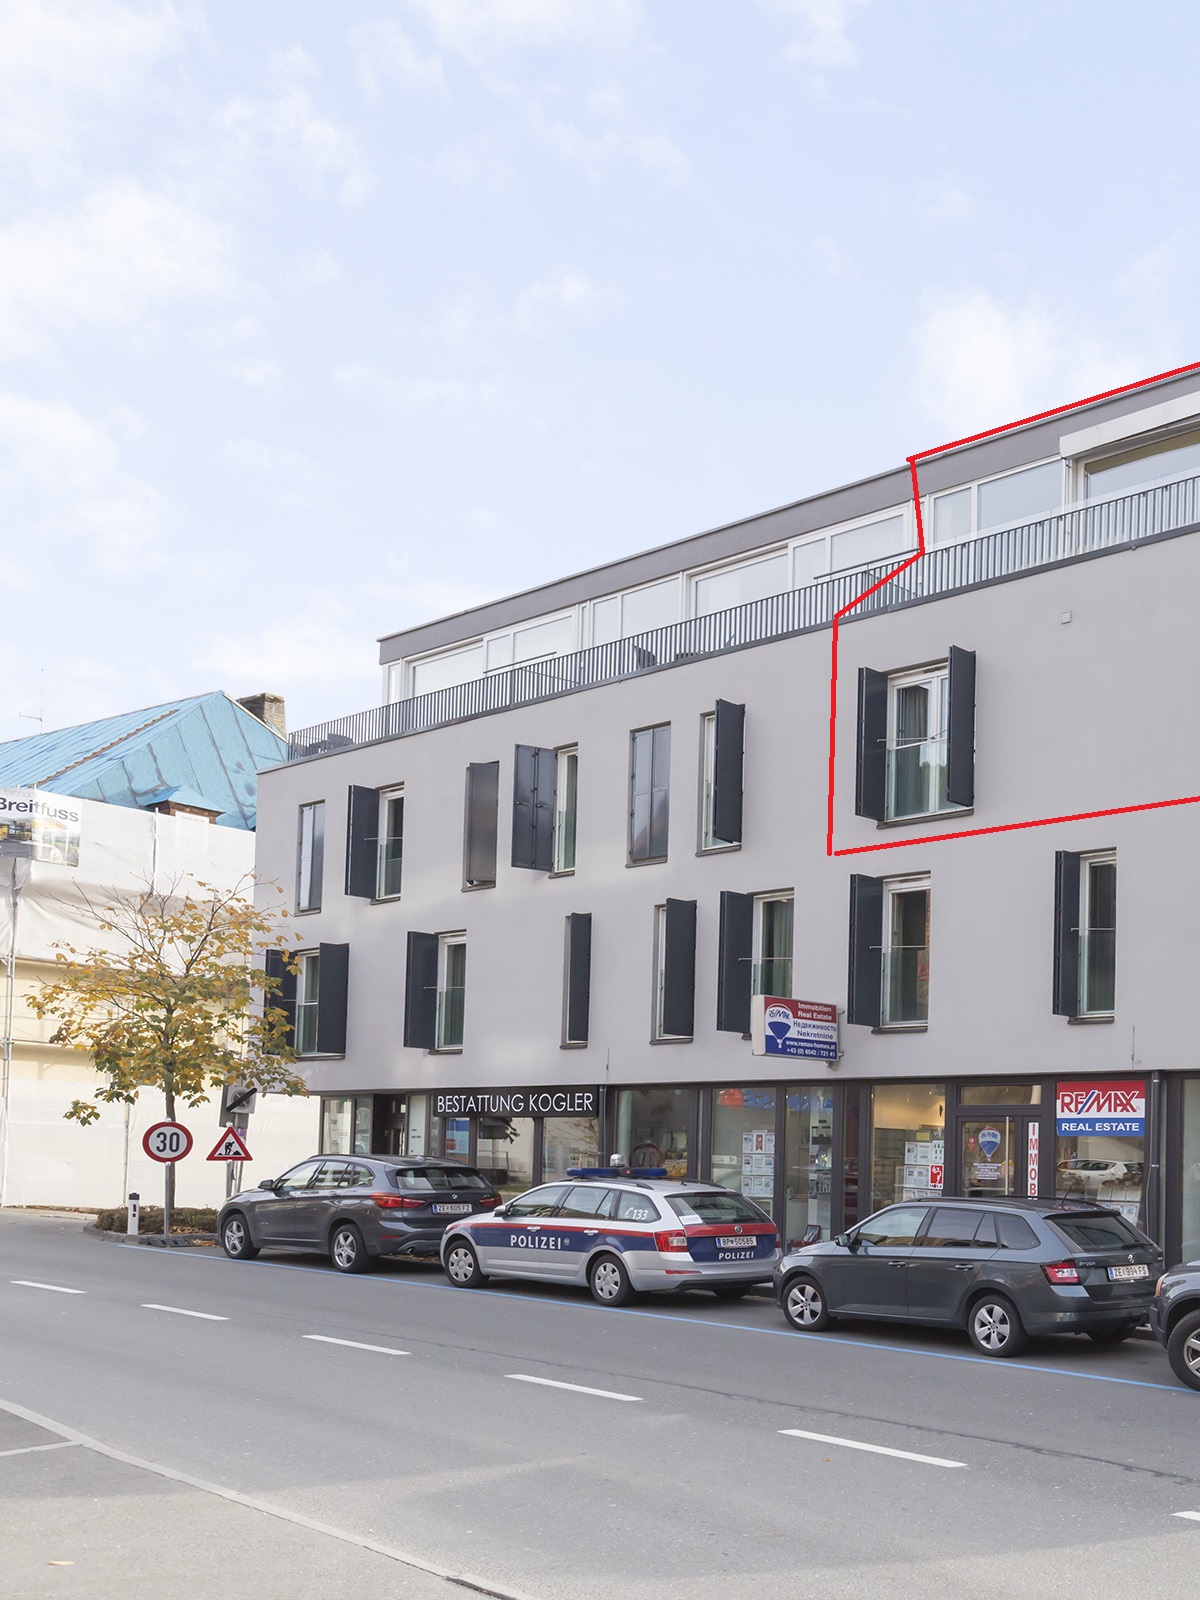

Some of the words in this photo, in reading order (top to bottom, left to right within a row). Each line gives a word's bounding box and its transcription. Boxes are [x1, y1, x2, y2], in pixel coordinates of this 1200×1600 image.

[0, 797, 79, 822] Breitfuss
[798, 1002, 832, 1012] Immobilien
[813, 1012, 832, 1020] Estate
[793, 1020, 836, 1032] Недвижимость
[797, 1030, 834, 1040] Nekretnine
[437, 1094, 524, 1113] BESTATTUNG
[529, 1093, 593, 1112] KOGLER
[1061, 1123, 1092, 1131] REAL
[1095, 1123, 1139, 1131] ESTATE
[156, 1132, 180, 1153] 30
[1029, 1123, 1039, 1200] IMMOB
[632, 1209, 649, 1221] 133
[510, 1235, 561, 1249] POLIZEI
[722, 1238, 730, 1246] BP
[718, 1251, 754, 1260] POLIZEI
[1114, 1268, 1122, 1277] ZE
[1138, 1266, 1147, 1275] FS
